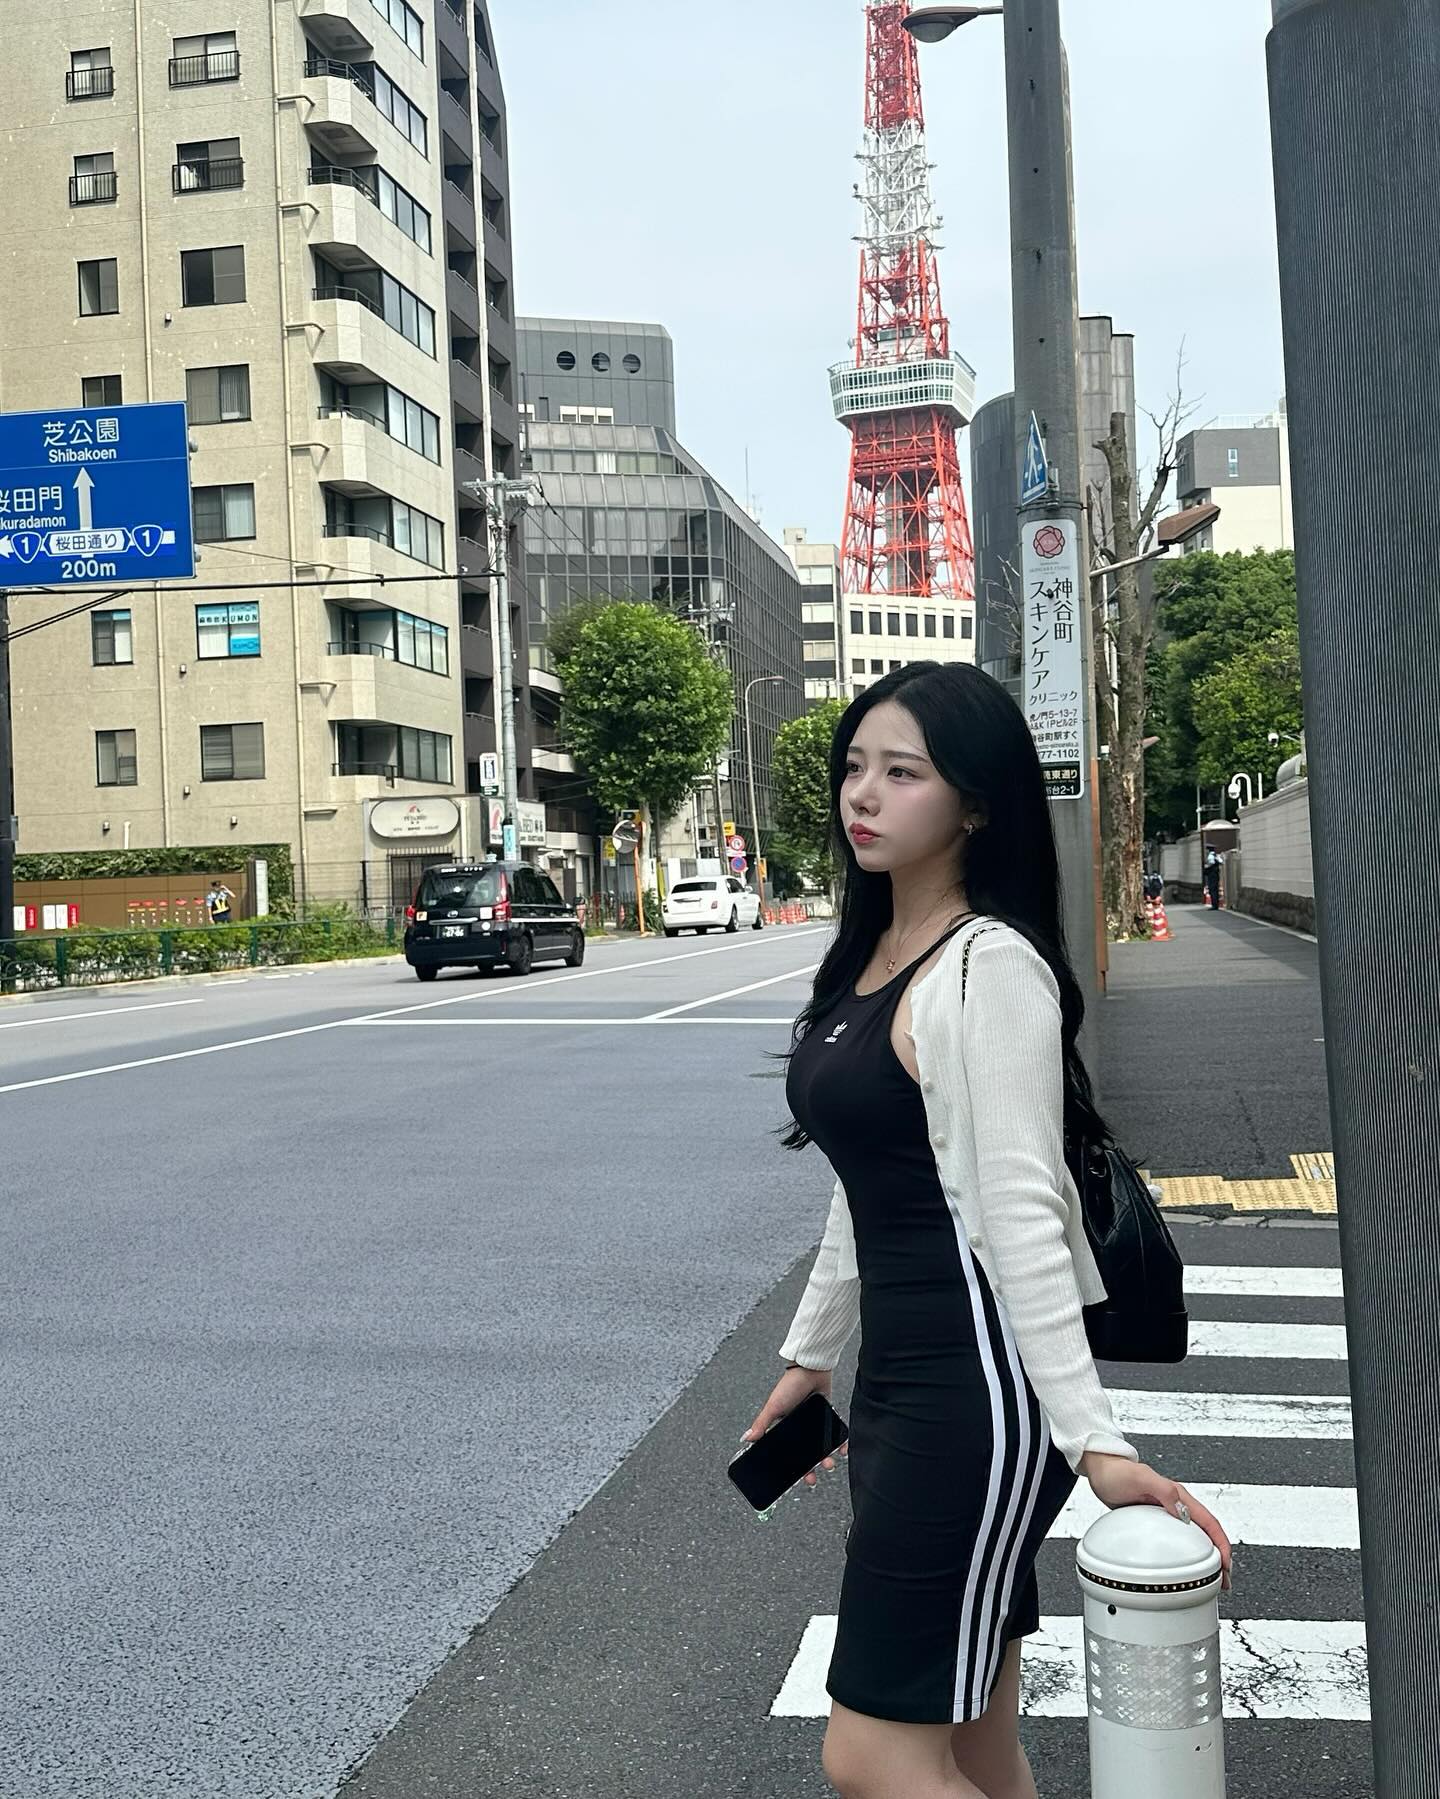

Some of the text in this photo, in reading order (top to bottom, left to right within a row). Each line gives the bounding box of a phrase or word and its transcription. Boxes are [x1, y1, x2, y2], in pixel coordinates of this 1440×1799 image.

[42, 417, 120, 448] 芝公園
[48, 448, 117, 464] Shibakoen
[21, 530, 151, 555] 1 桜田通り 1
[61, 559, 117, 578] 200m
[1053, 577, 1075, 643] 神谷町
[1029, 580, 1050, 690] スキンケア
[1029, 690, 1078, 705] クリニック
